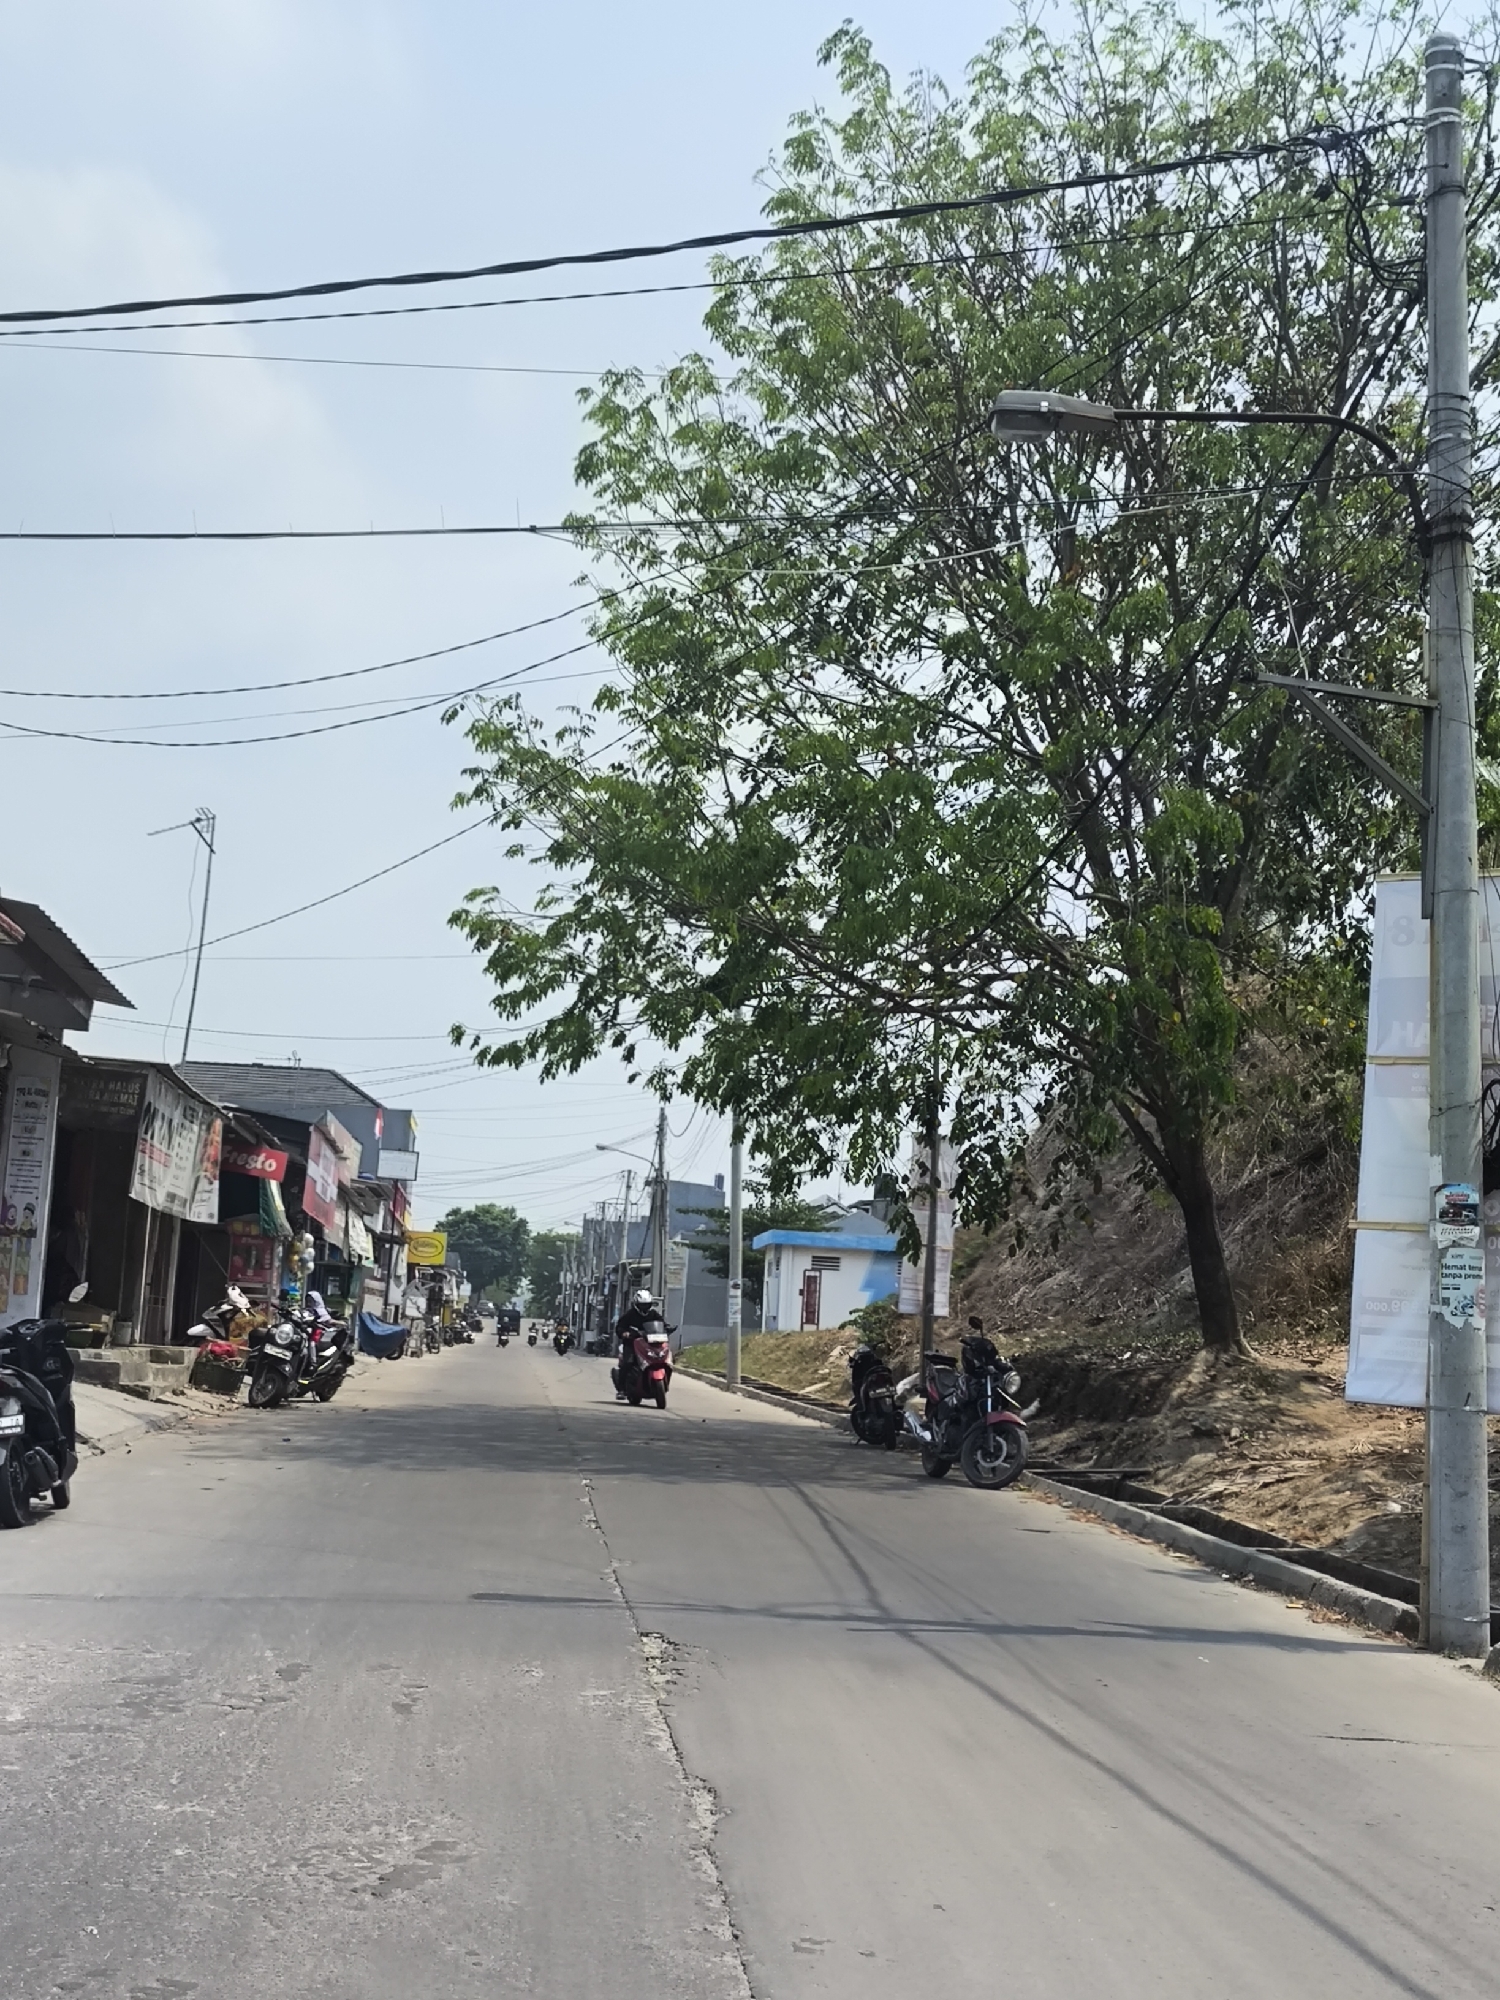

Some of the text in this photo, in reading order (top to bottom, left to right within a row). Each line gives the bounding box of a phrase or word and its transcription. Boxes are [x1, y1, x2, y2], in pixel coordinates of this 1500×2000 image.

[108, 1081, 141, 1094] HALUS
[223, 1145, 277, 1173] Fresto
[1441, 1262, 1467, 1271] Hemat
[1441, 1272, 1462, 1280] tanpa
